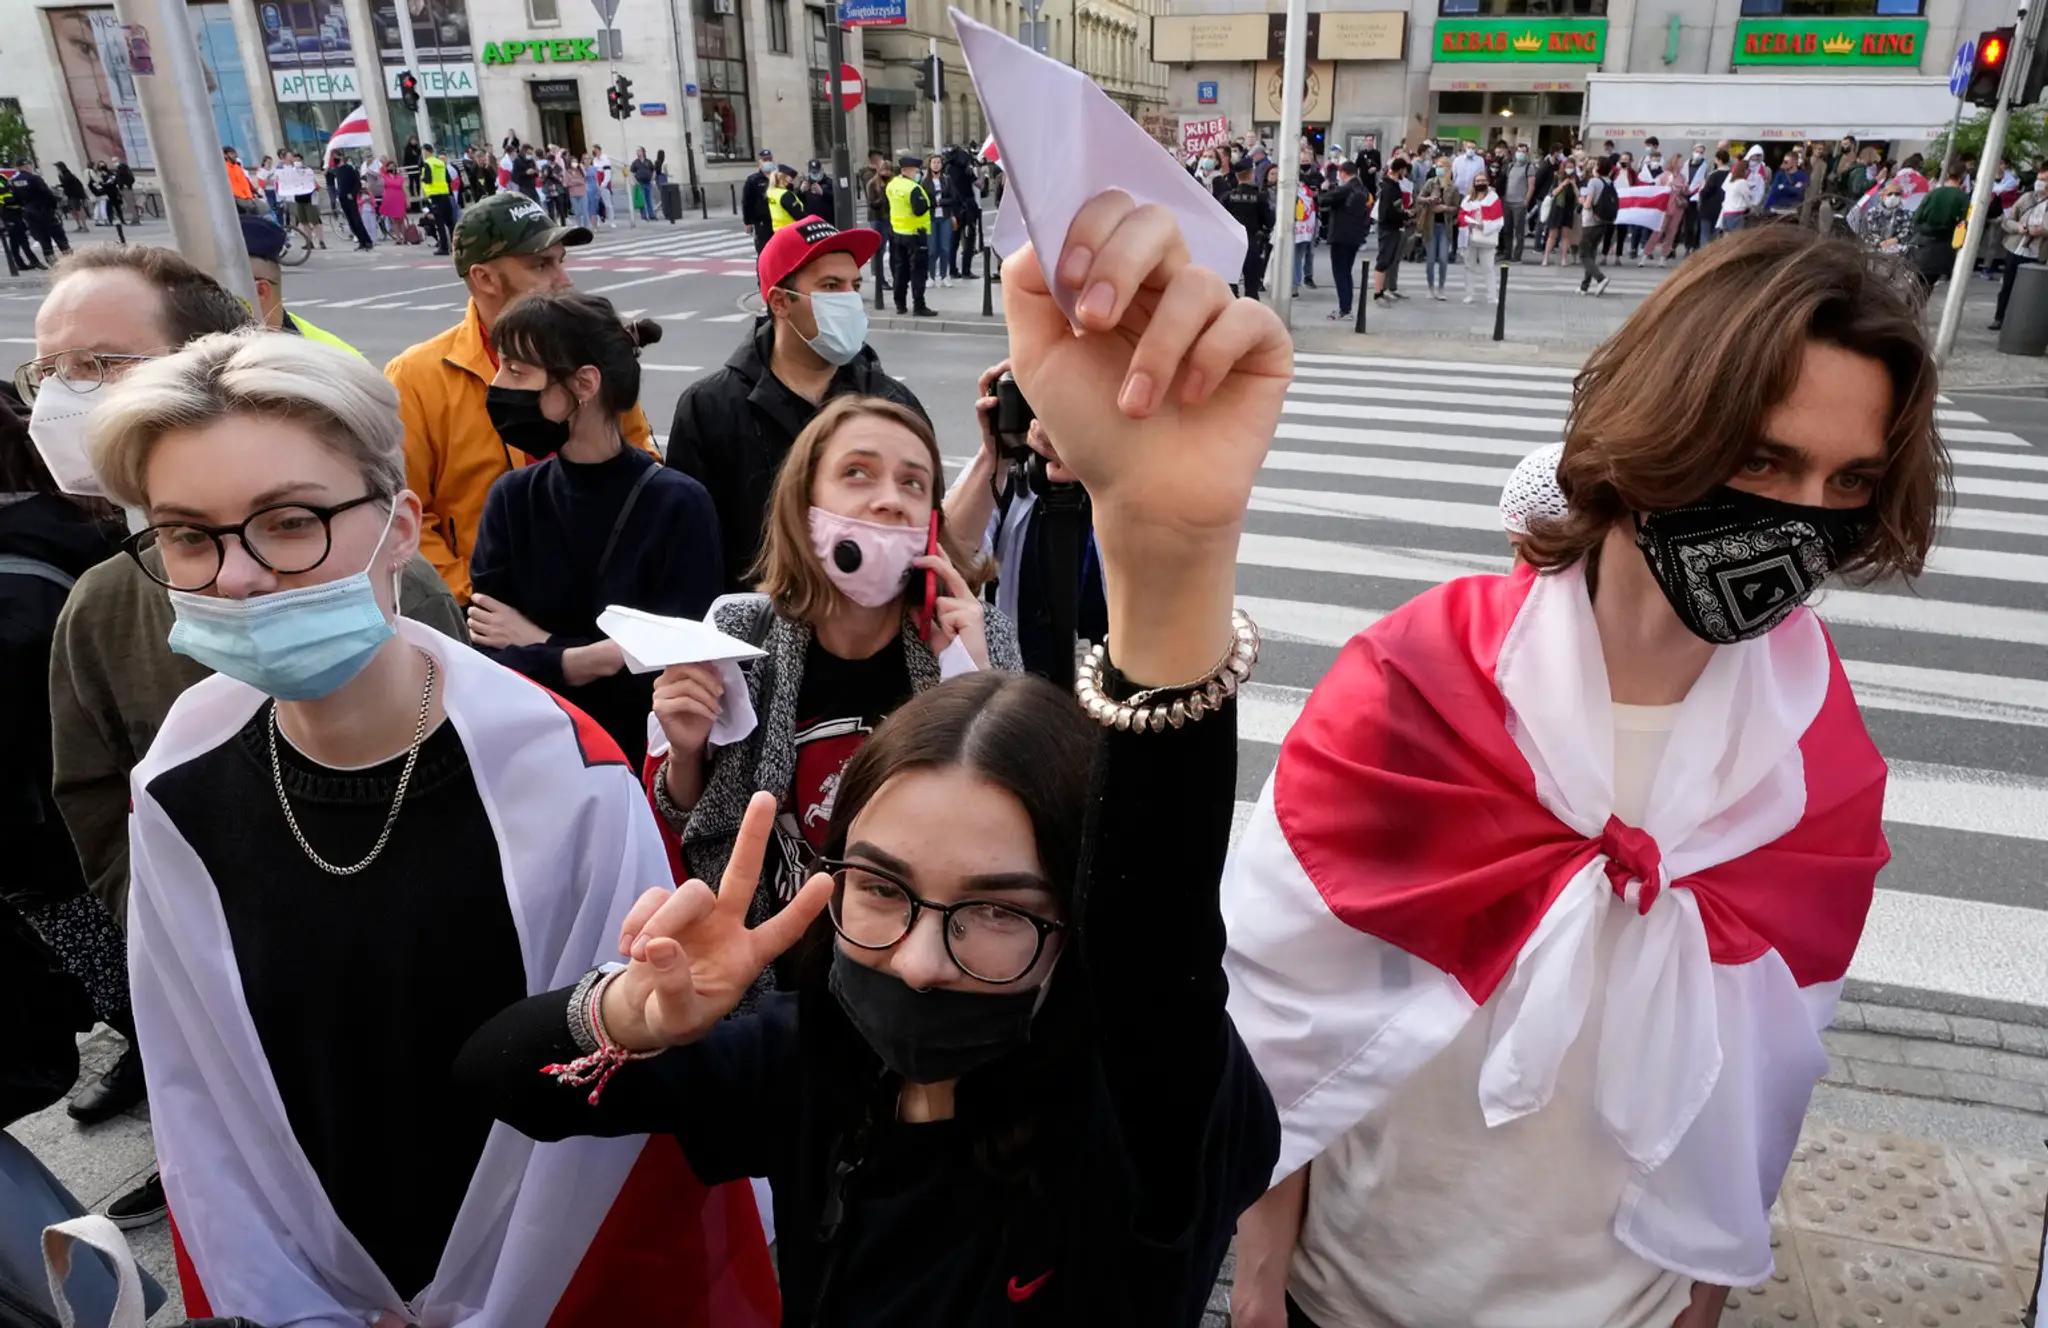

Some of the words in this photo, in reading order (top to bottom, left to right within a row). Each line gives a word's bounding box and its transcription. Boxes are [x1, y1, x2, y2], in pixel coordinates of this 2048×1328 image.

[846, 2, 901, 19] Świętokrzyska
[91, 16, 119, 28] VICH
[481, 37, 600, 65] APTEK
[1442, 32, 1508, 52] KEBAB
[1547, 31, 1597, 52] KING
[1744, 32, 1818, 53] KEBAB
[1860, 32, 1915, 55] KING
[282, 74, 355, 95] APTEKA
[394, 70, 473, 92] ATEKA
[1203, 86, 1213, 98] 18
